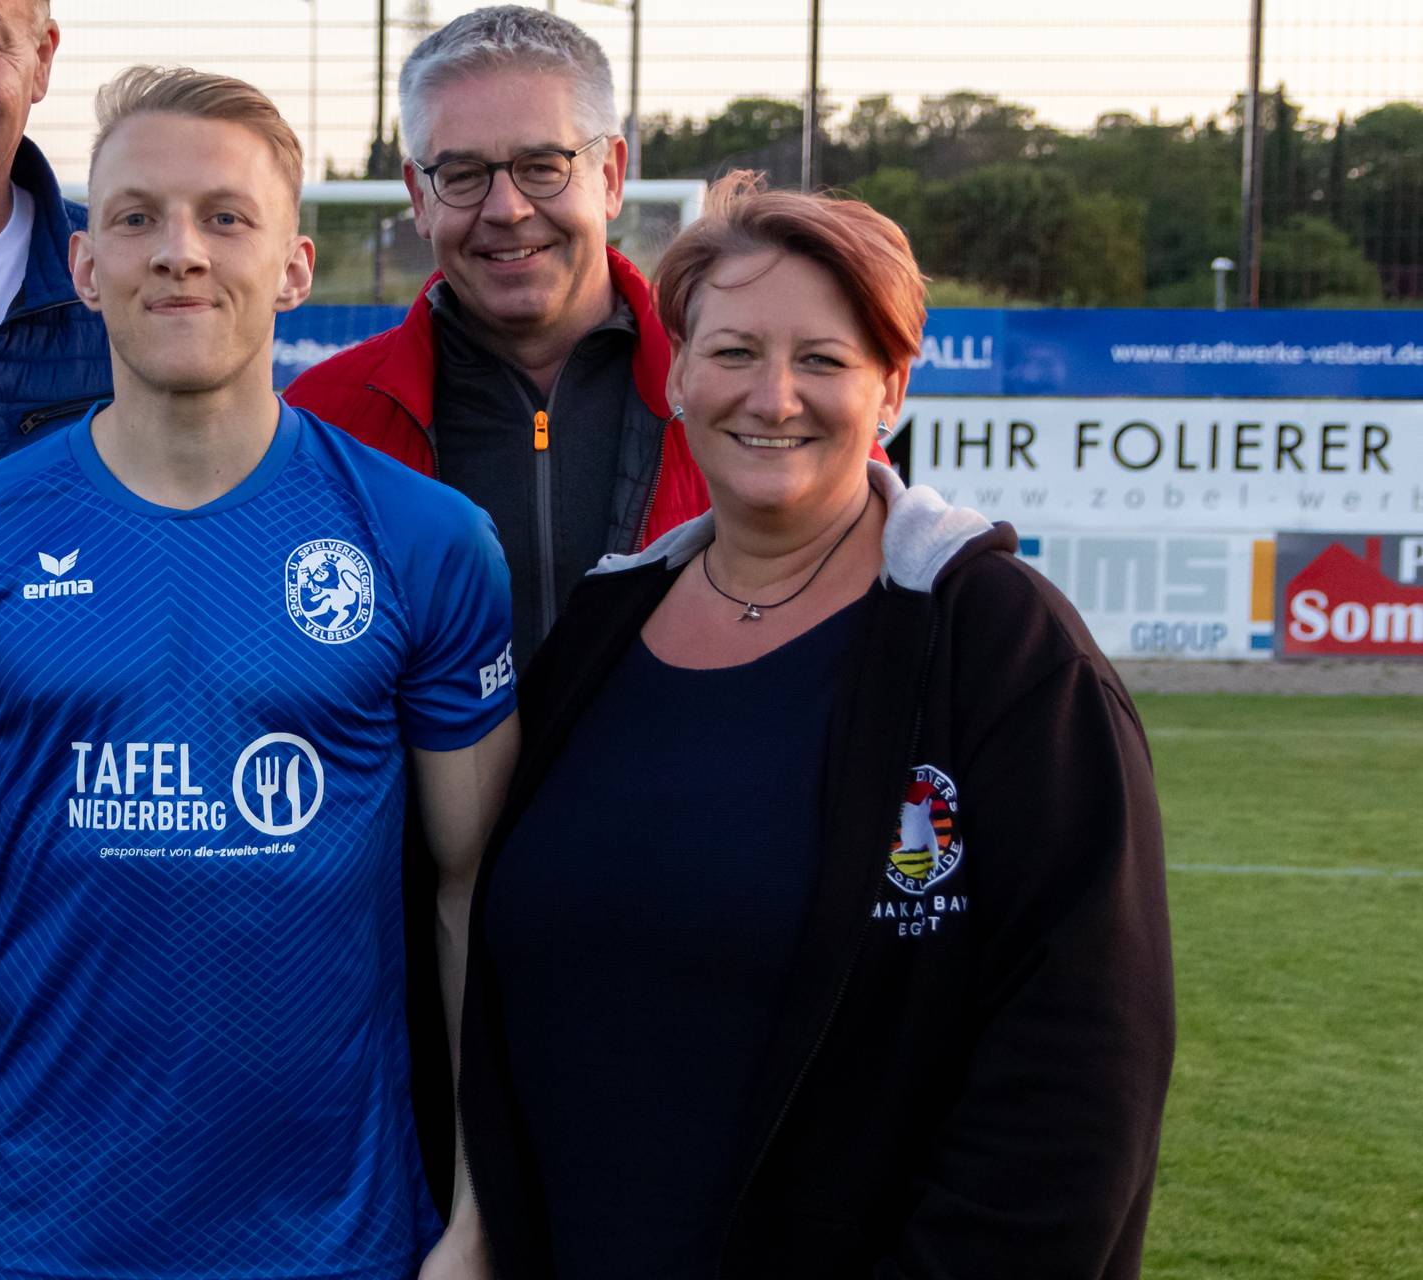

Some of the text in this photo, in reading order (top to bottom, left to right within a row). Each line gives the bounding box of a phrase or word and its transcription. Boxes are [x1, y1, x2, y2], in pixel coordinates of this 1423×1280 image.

[929, 420, 1393, 474] IHR FOLIERER
[23, 579, 94, 600] erima
[289, 582, 303, 618] SPORT
[298, 542, 370, 604] SPIELVEREINIGUNG
[359, 609, 369, 623] 02
[305, 622, 357, 641] VELBERT
[1289, 589, 1423, 643] Som
[1131, 622, 1227, 650] GROUP
[71, 741, 203, 796] TAFEL
[68, 797, 227, 832] NIEDERBERG
[99, 842, 296, 860] gesponsert von die-zweite-elf.de
